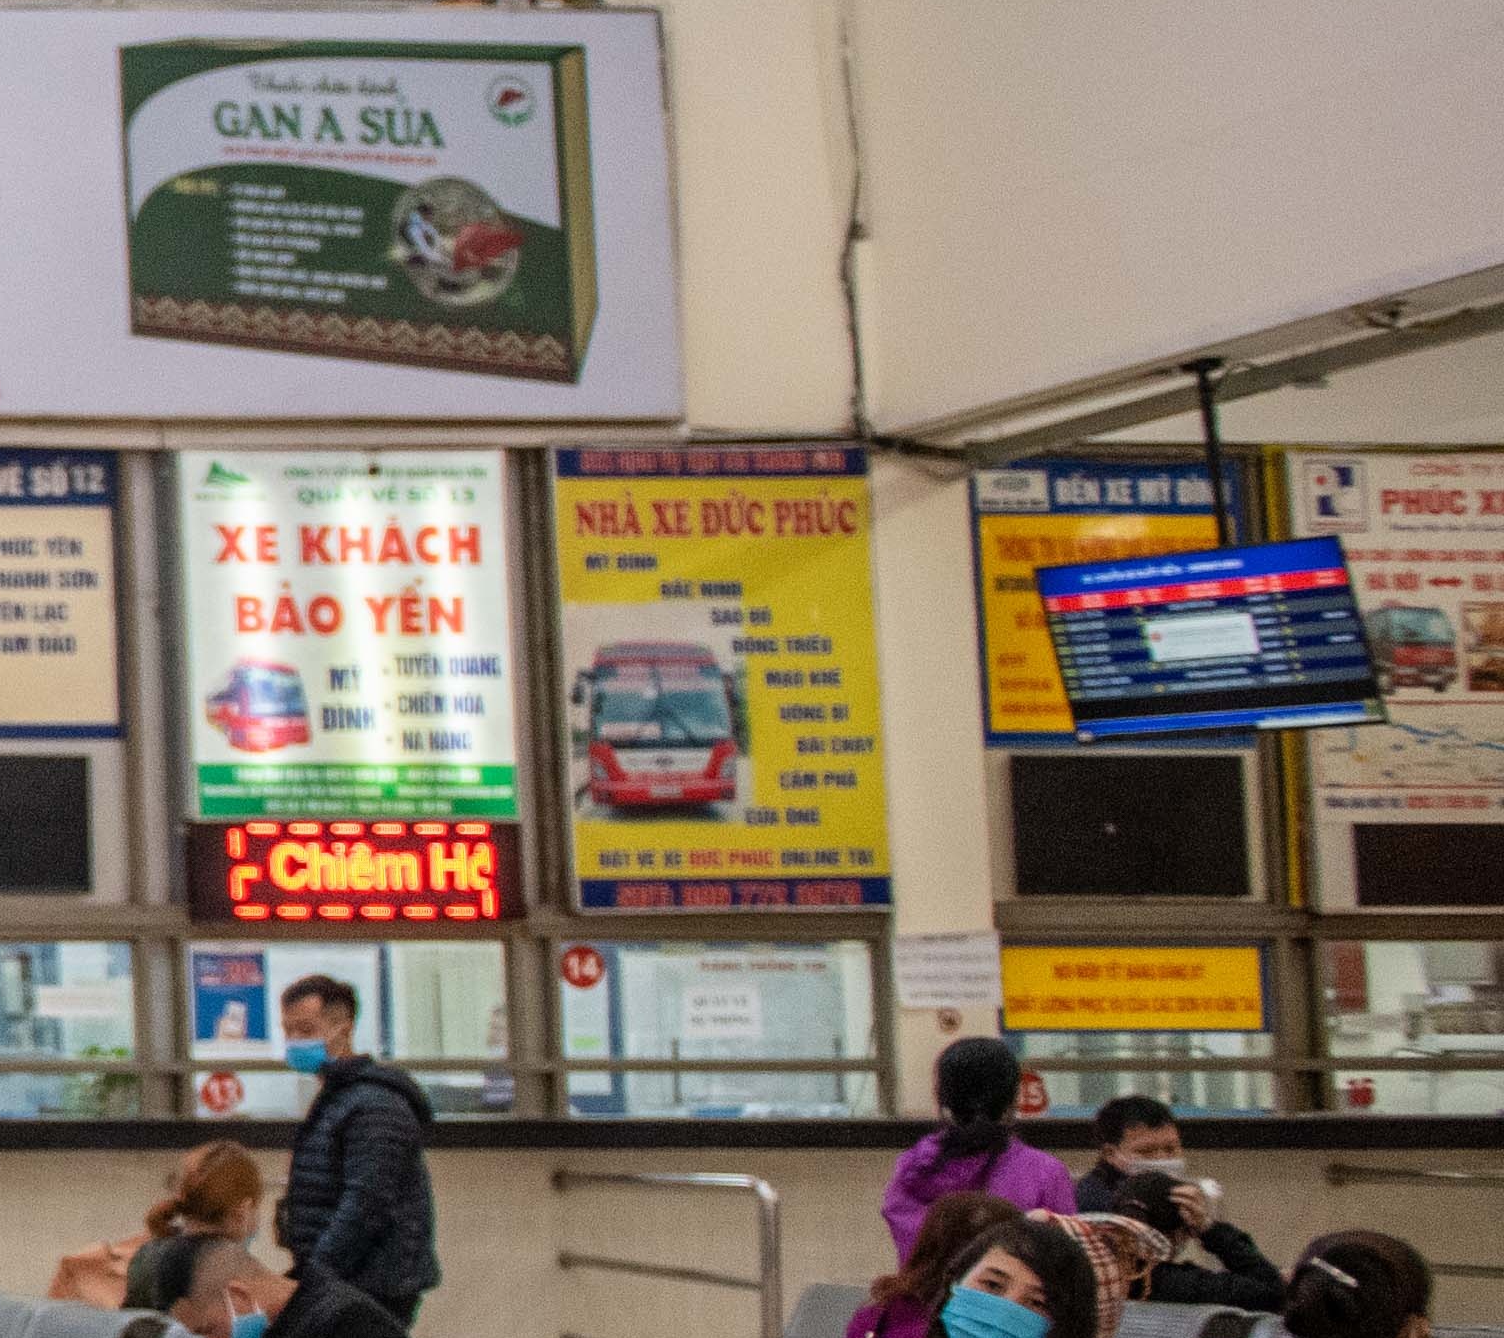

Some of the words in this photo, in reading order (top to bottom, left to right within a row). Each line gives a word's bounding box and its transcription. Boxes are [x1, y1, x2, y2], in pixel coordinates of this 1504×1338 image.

[212, 101, 302, 140] GAN
[314, 107, 346, 145] A
[574, 491, 643, 538] NHÀ
[651, 499, 690, 537] XE
[774, 491, 858, 538] PHÚC
[215, 525, 280, 565] XE
[299, 516, 483, 565] KHÁCH
[233, 579, 344, 636] BẢO
[269, 841, 421, 893] Chiêm
